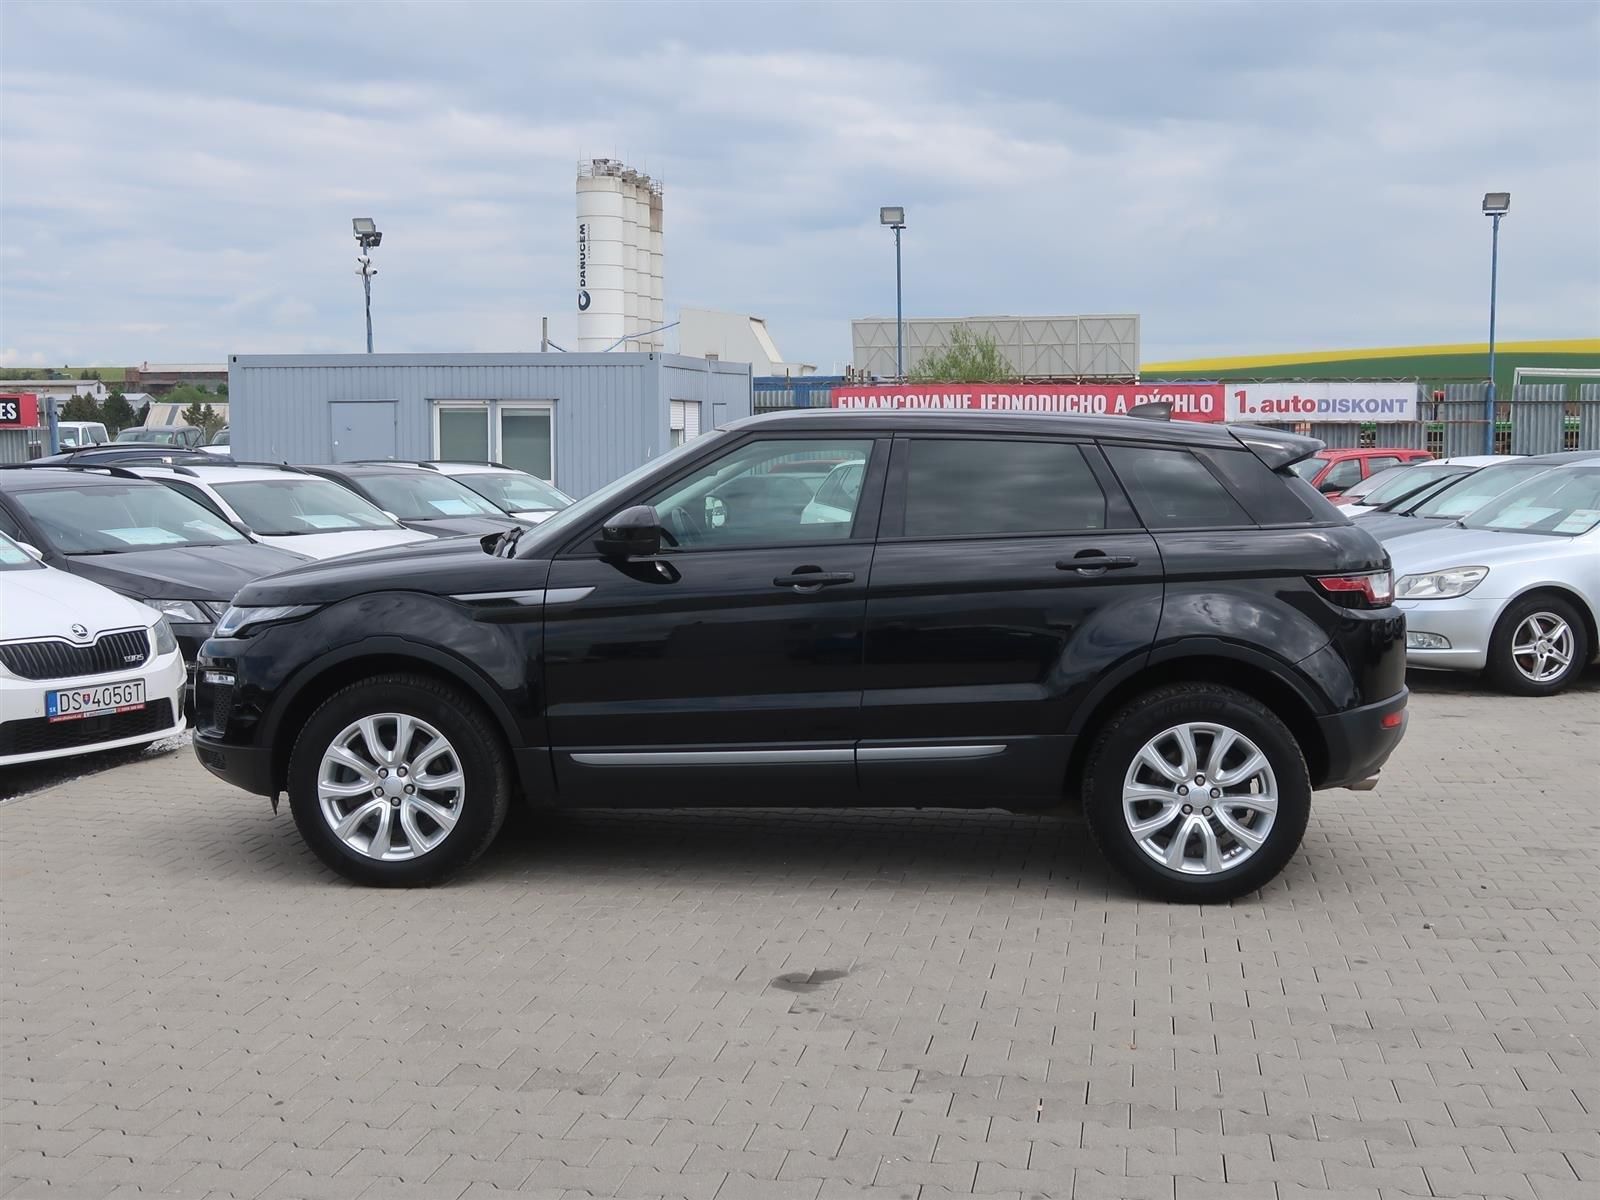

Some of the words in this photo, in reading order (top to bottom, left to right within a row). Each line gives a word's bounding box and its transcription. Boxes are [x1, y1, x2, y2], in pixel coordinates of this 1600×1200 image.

[837, 394, 972, 409] FINANCOVANIE
[980, 394, 1107, 414] JEDNODUCHO
[1114, 395, 1127, 414] A
[1234, 390, 1257, 414] 1.
[1260, 395, 1408, 414] autoDISKONT
[60, 692, 82, 712] DS
[92, 683, 141, 707] 405GT
